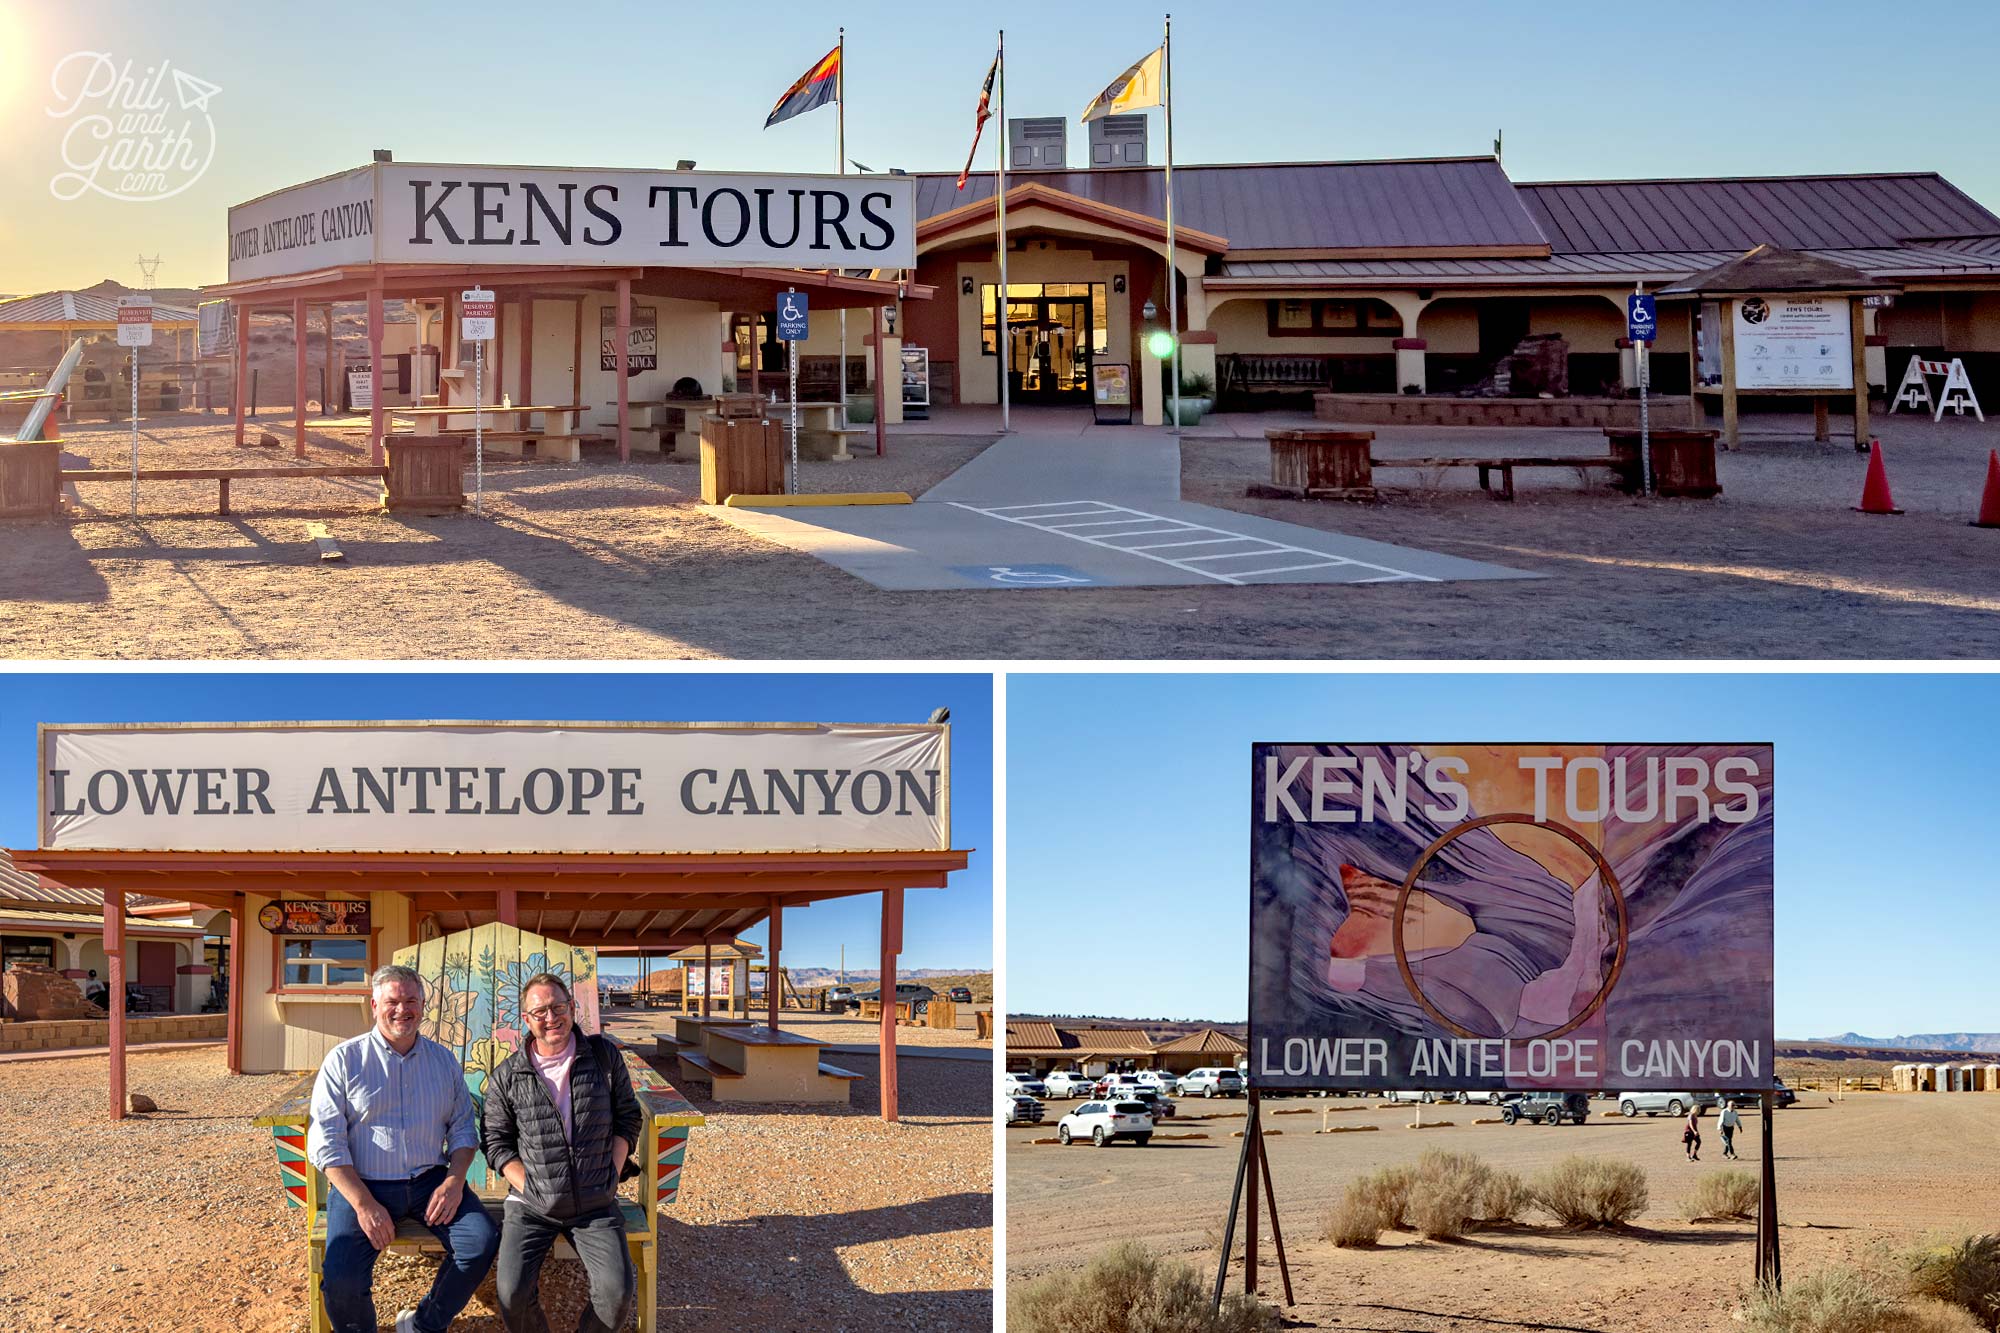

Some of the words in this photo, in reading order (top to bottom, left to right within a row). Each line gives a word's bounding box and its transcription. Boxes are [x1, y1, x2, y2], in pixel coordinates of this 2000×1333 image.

[230, 227, 260, 262] LOWER
[262, 212, 316, 254] ANTELOPE
[321, 199, 374, 242] CANYON
[408, 180, 623, 247] KENS
[648, 185, 896, 251] TOURS
[627, 356, 655, 369] SHACK
[49, 768, 276, 816] LOWER
[307, 766, 645, 815] ANTELOPE
[680, 767, 940, 816] CANYON
[1264, 751, 1470, 823] KEN'S
[1518, 756, 1760, 824] TOURS
[284, 902, 319, 913] KENS
[327, 902, 367, 913] TOURS
[292, 924, 320, 934] SNOW
[325, 924, 358, 934] SHACK
[1261, 1038, 1388, 1077] LOWER
[1409, 1038, 1598, 1078] ANTELOPE
[1621, 1038, 1760, 1078] CANYON
